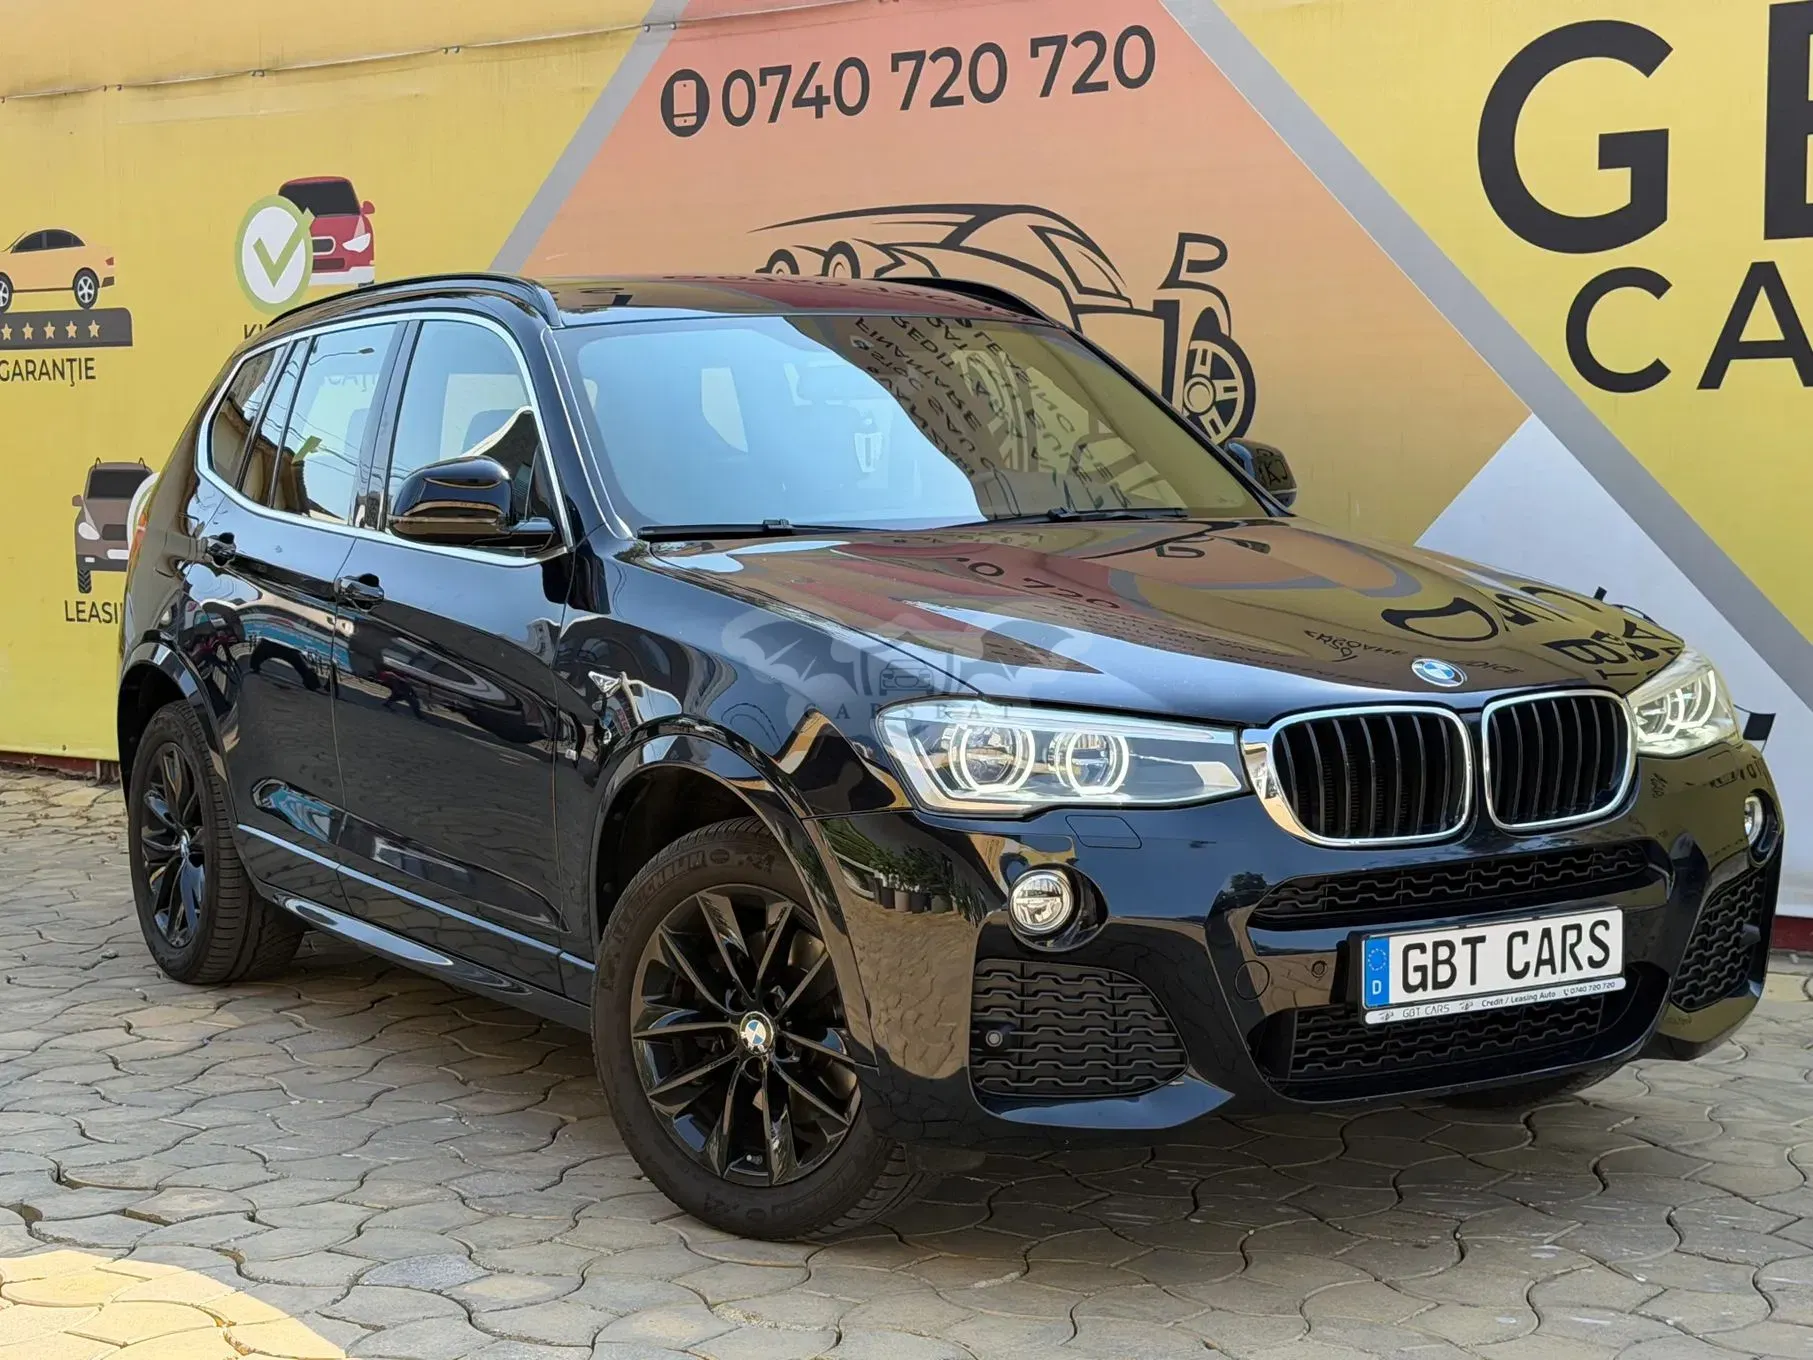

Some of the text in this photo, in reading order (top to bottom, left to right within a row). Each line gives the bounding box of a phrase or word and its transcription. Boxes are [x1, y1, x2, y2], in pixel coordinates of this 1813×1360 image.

[721, 24, 1156, 127] 0740 720 720
[64, 599, 123, 625] LEASI
[1402, 919, 1610, 993] GBT CARS
[1372, 980, 1382, 995] D
[1424, 1004, 1450, 1016] CARS
[1481, 996, 1504, 1007] Credit
[1511, 993, 1538, 1004] Leasing
[1540, 990, 1556, 1000] Auto
